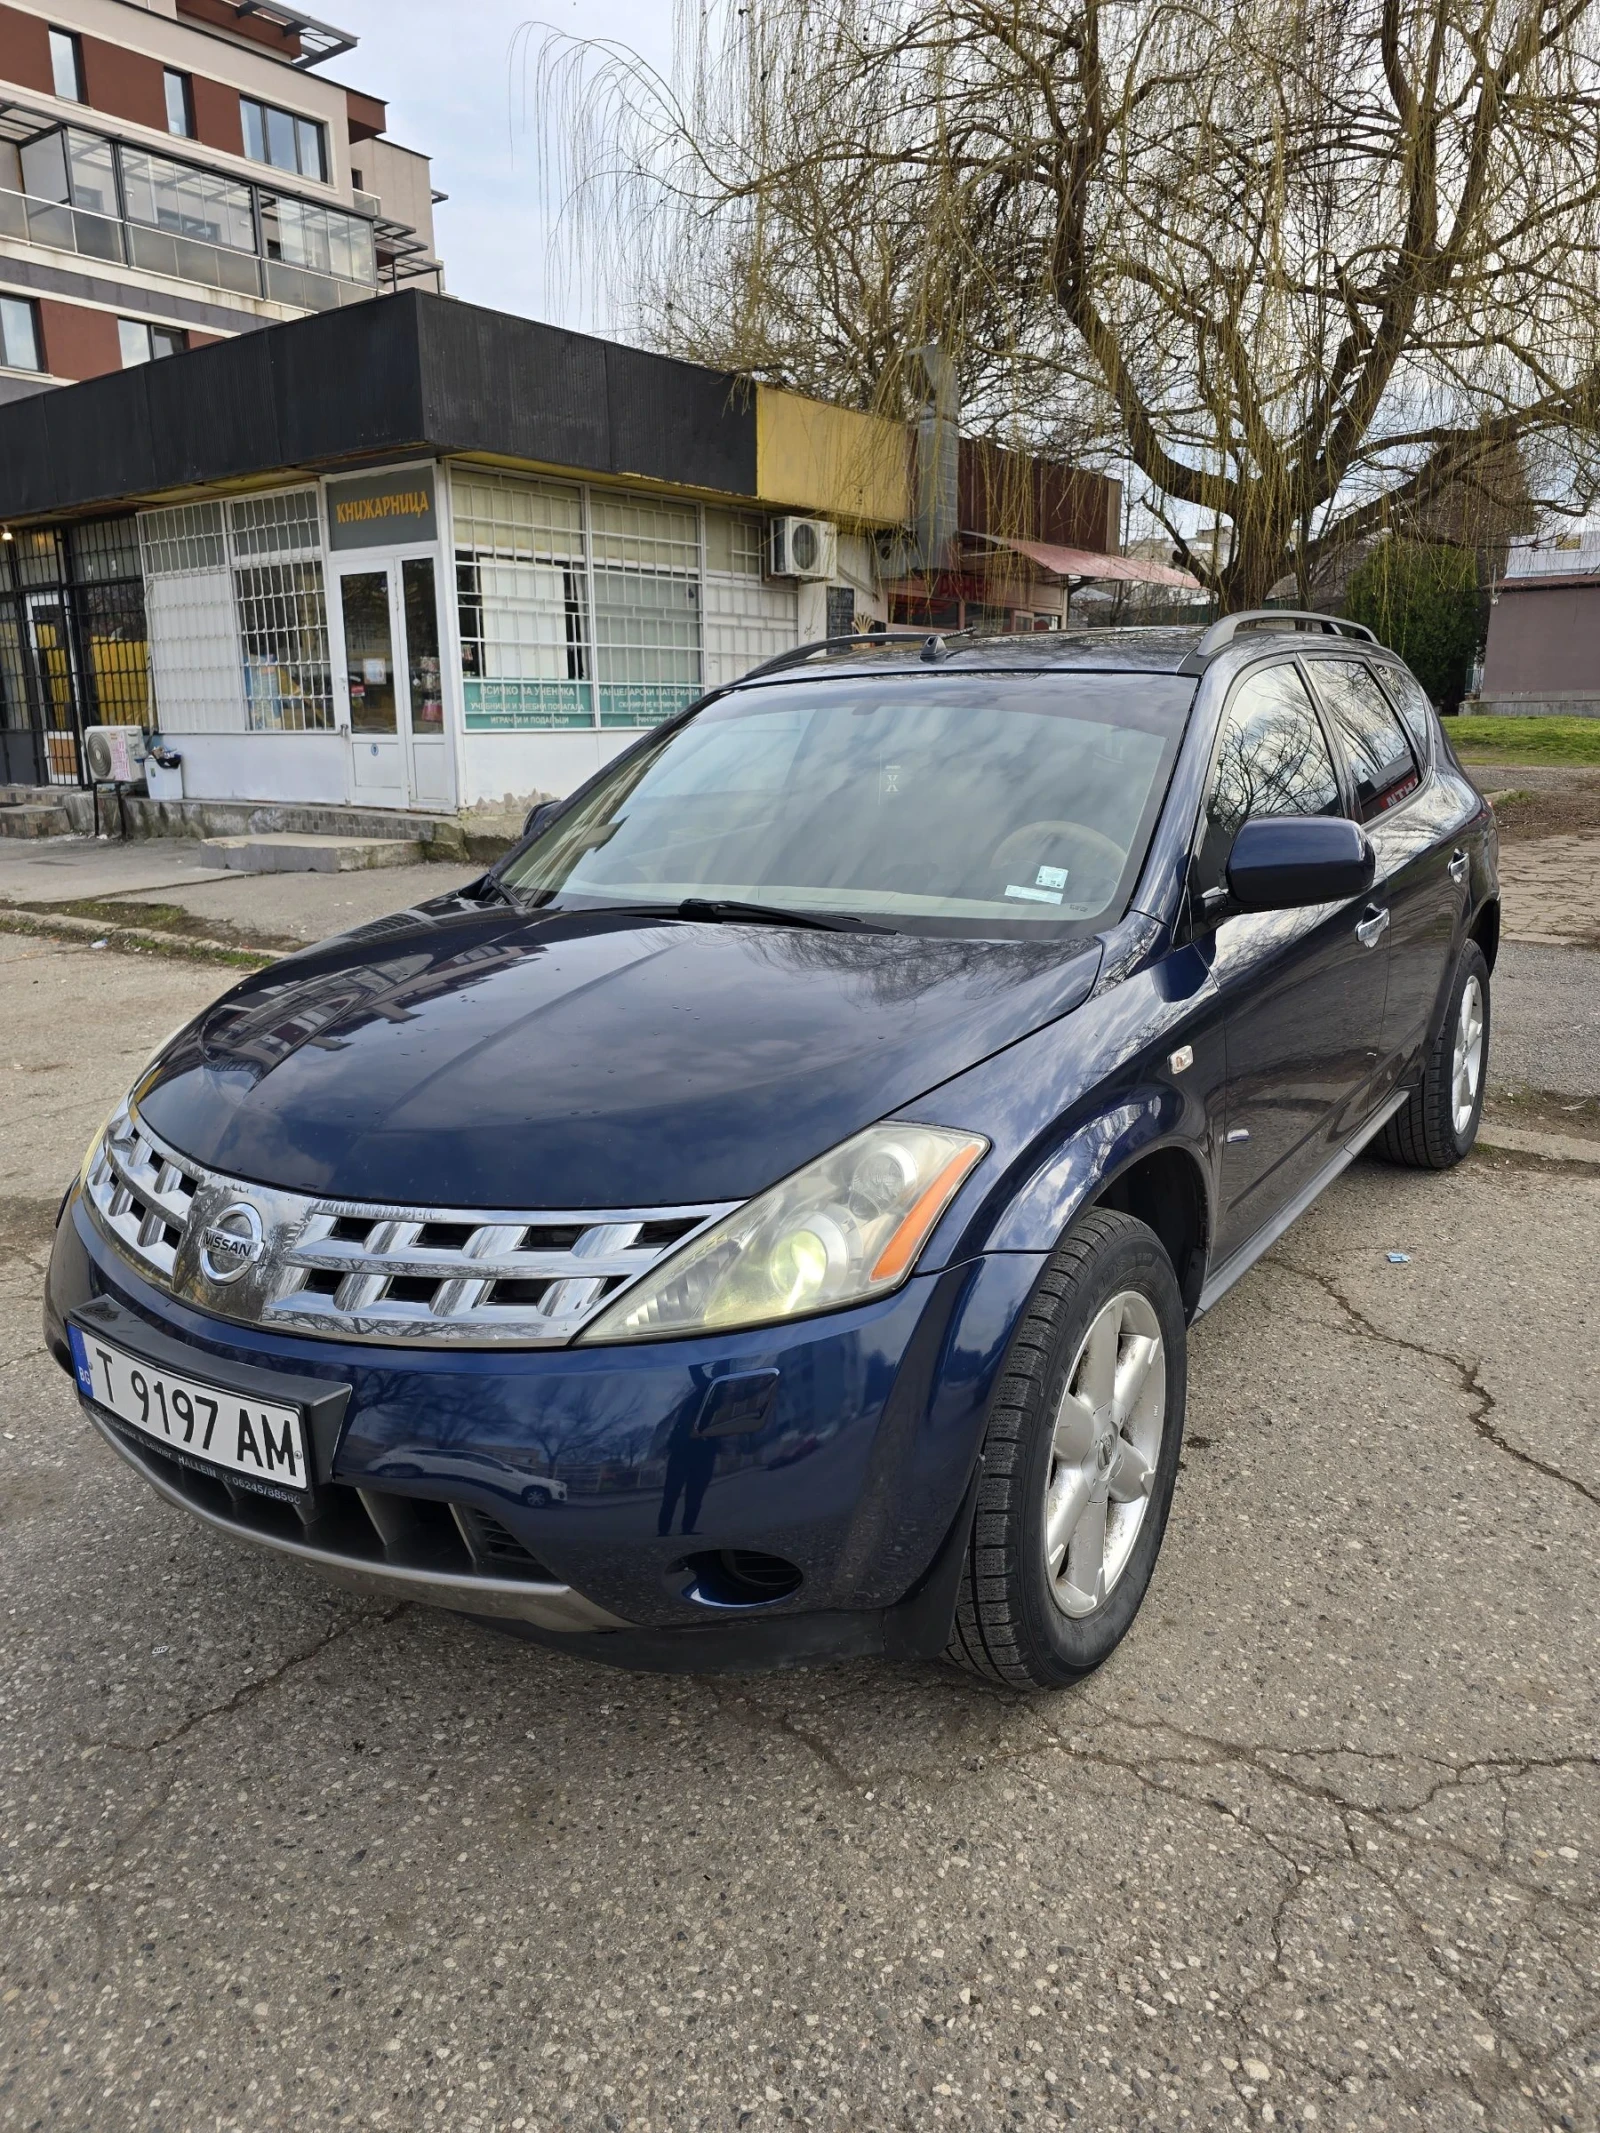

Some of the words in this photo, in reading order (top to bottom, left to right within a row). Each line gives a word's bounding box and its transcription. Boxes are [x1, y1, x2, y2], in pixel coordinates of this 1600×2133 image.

[336, 490, 429, 524] КНИЖАРНИЦА
[534, 686, 575, 696] УЧЕНИКА
[204, 1231, 252, 1257] NISSAN
[78, 1366, 91, 1385] BG
[96, 1347, 113, 1403] T
[131, 1370, 219, 1451] 9197
[237, 1408, 297, 1477] AM
[178, 1455, 217, 1478] HALLEIN
